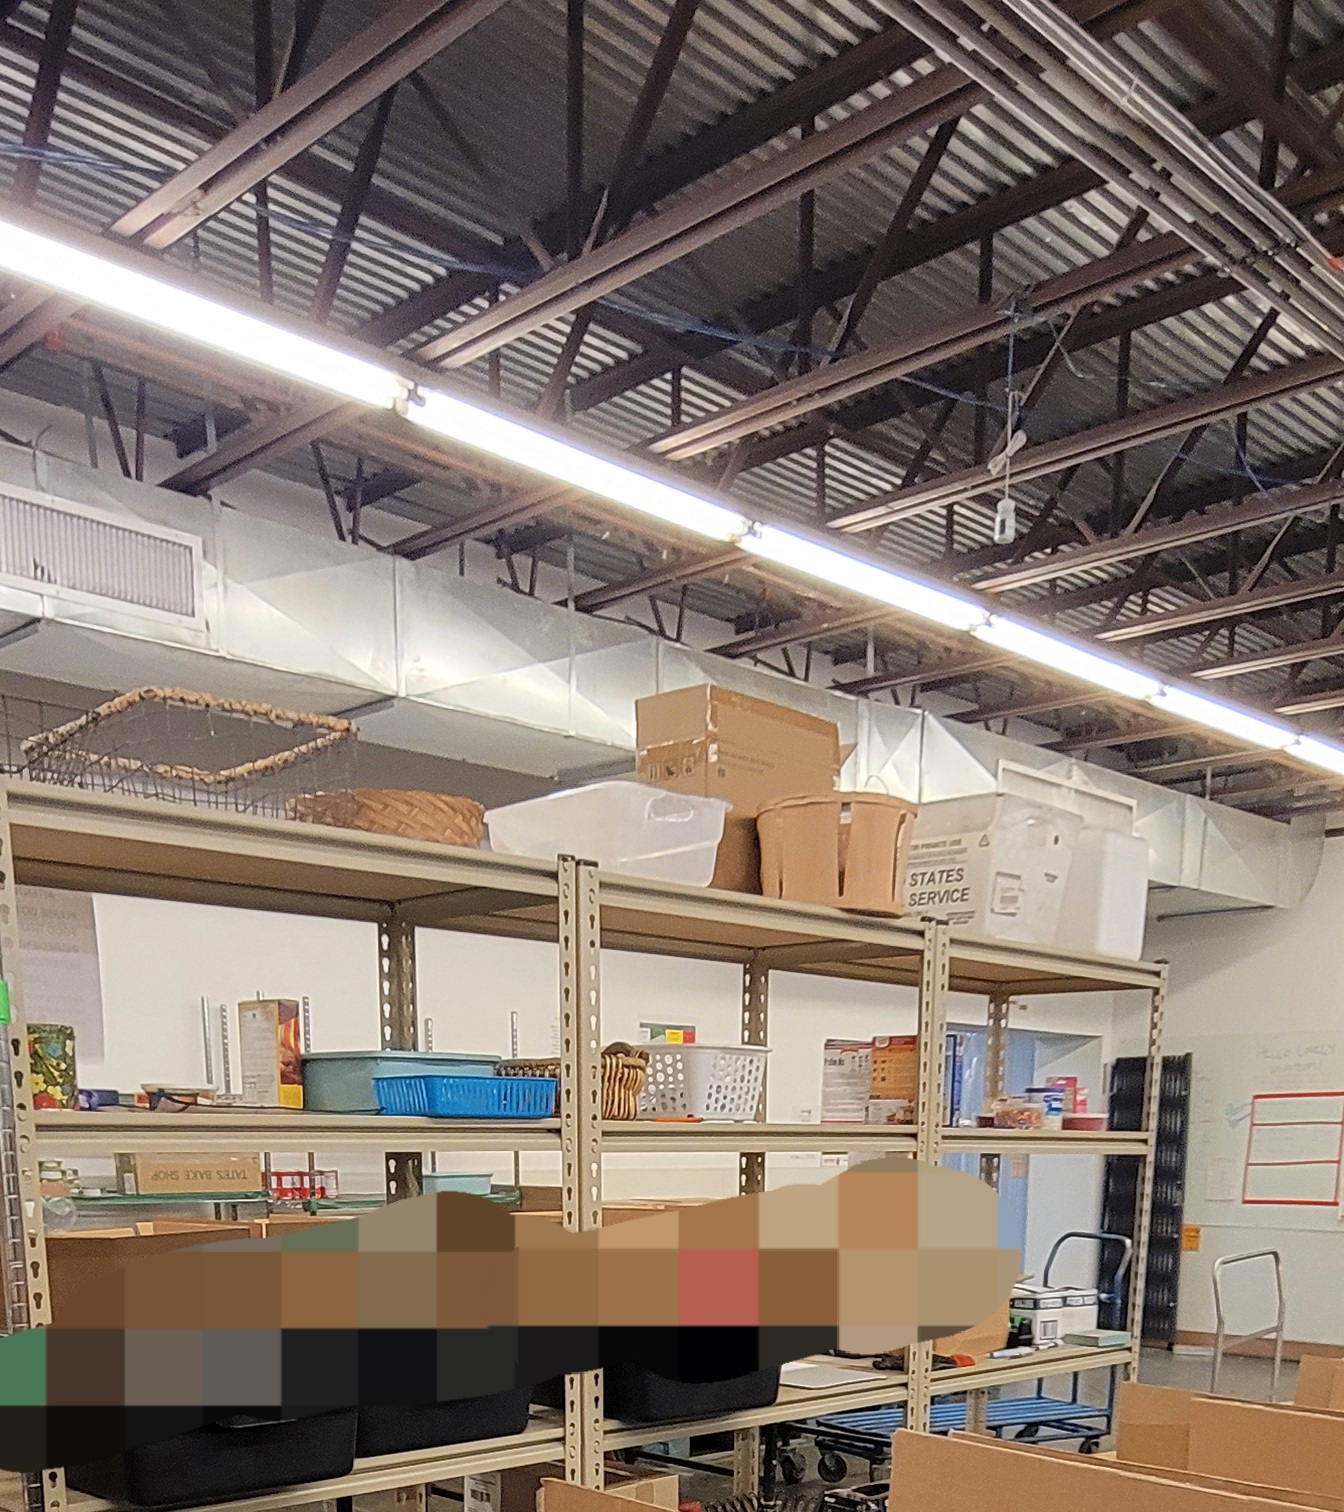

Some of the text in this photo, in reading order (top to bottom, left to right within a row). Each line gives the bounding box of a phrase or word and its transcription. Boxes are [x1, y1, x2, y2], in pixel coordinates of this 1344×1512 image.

[909, 868, 964, 887] STATES
[908, 887, 971, 907] SERVICE
[151, 1170, 179, 1180] SHOP
[186, 1170, 212, 1180] BAKE
